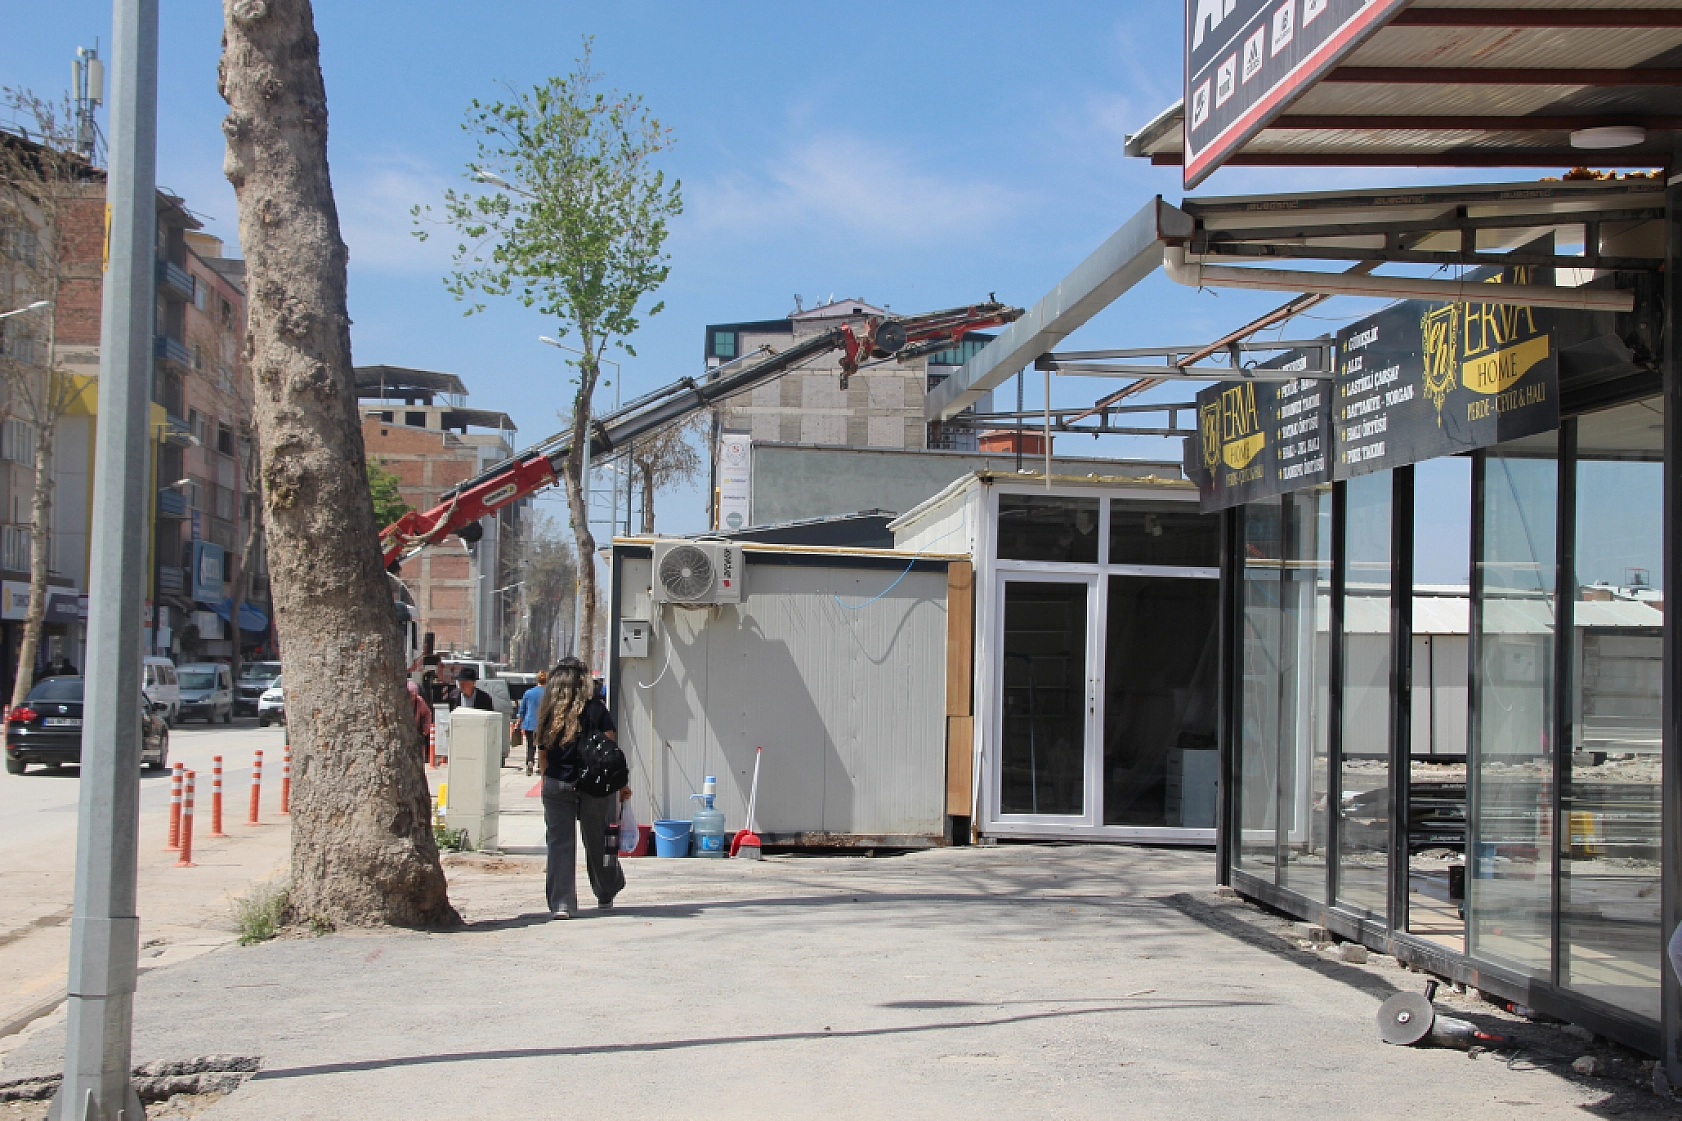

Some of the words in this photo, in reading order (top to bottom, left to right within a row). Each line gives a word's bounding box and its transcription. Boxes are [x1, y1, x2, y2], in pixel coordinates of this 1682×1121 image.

[1478, 352, 1518, 388] HOME
[1222, 381, 1260, 441] ERVA
[1467, 398, 1490, 422] PERDE
[1230, 441, 1250, 464] HOME
